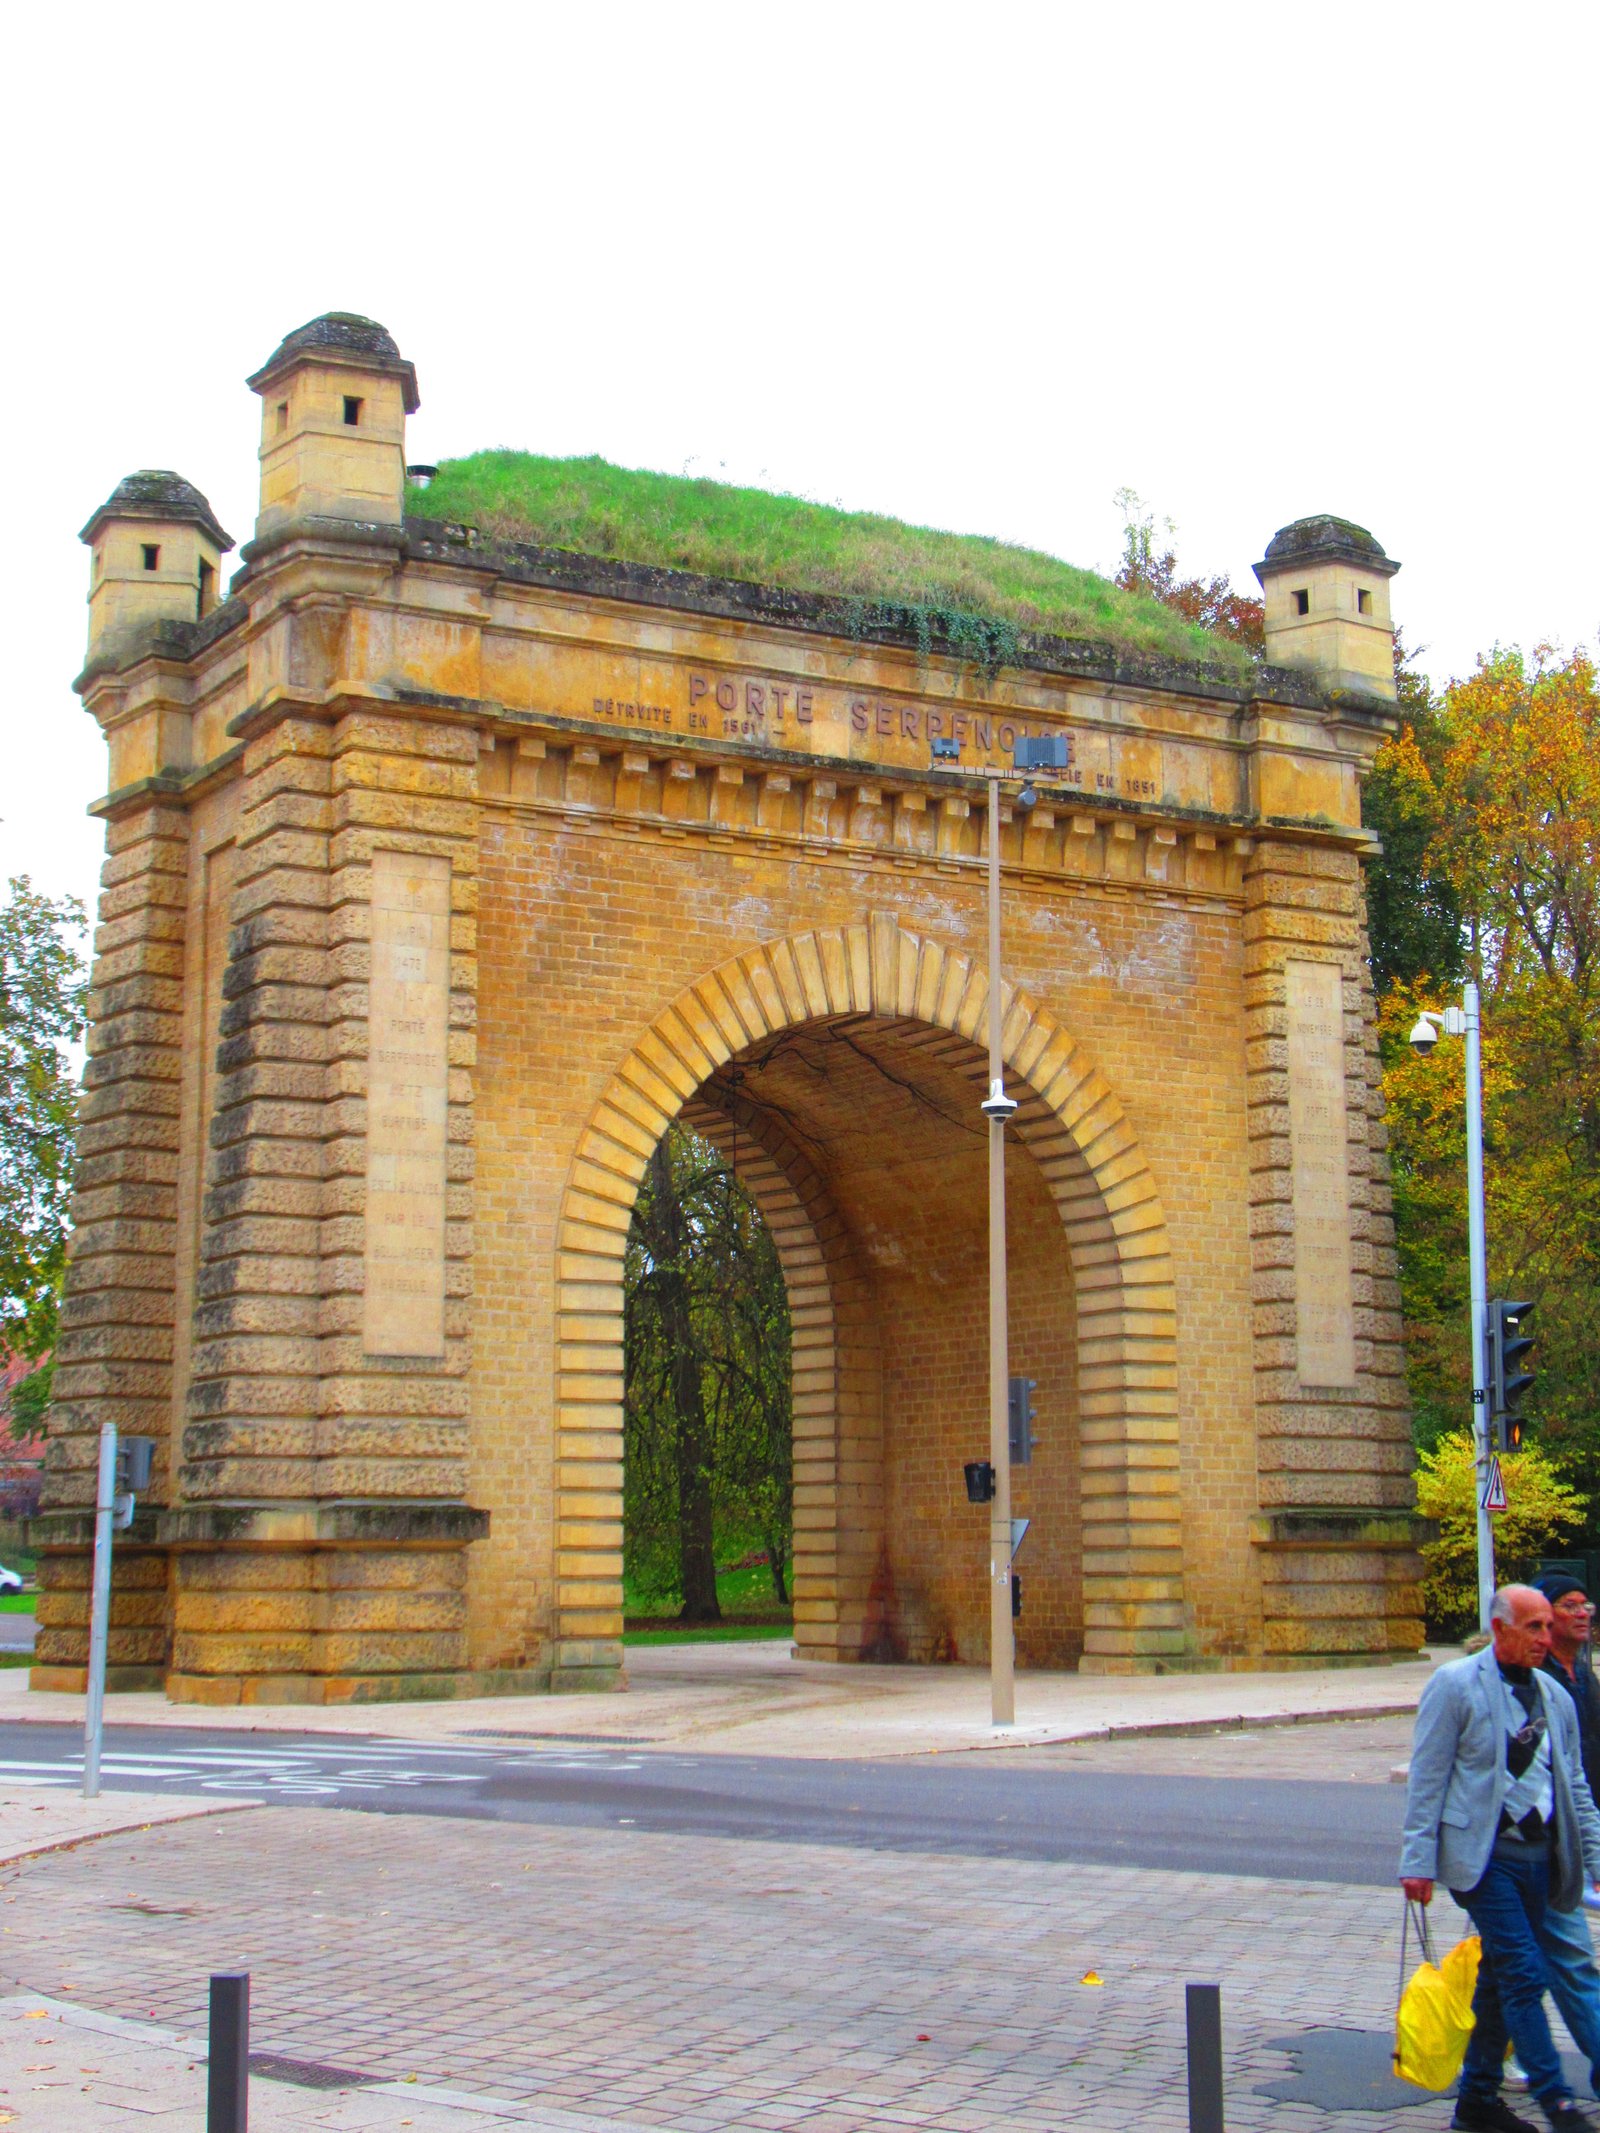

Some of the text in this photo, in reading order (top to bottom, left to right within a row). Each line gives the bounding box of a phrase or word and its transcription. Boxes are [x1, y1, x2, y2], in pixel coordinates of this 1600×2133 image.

[689, 672, 1075, 763] PORTE SERPENOE
[690, 712, 708, 729] EN
[723, 719, 756, 736] 1561
[1096, 773, 1114, 789] EN
[1126, 778, 1156, 795] 1851
[391, 1018, 426, 1035] PORTE
[1296, 1022, 1333, 1036] NOVEMBRE
